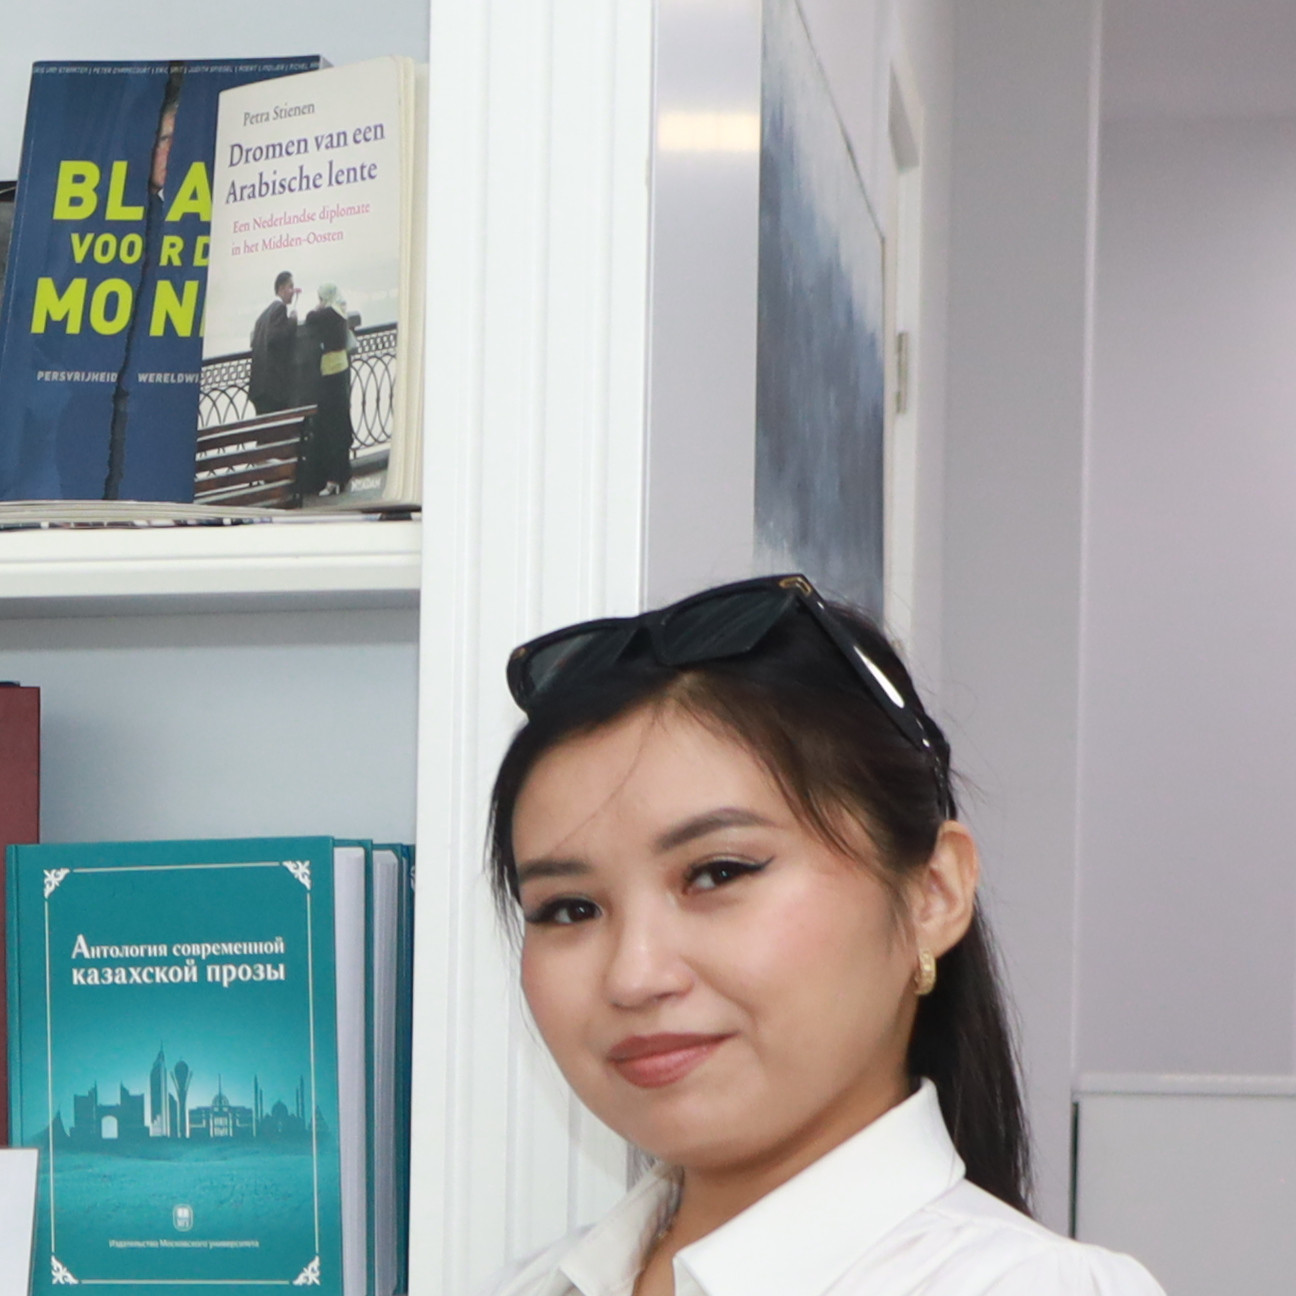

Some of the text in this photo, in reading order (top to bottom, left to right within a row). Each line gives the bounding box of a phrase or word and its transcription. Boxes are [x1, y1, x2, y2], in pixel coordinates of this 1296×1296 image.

[242, 103, 316, 127] Petra Stienen
[228, 122, 386, 169] Dromen van een
[224, 159, 379, 205] Arabische lente
[233, 203, 371, 234] Een Nederlandse diplomate
[231, 230, 345, 257] in het Midden-Oosten
[30, 277, 205, 338] MON
[71, 933, 286, 960] Антология современной
[72, 958, 286, 988] казахской прозы
